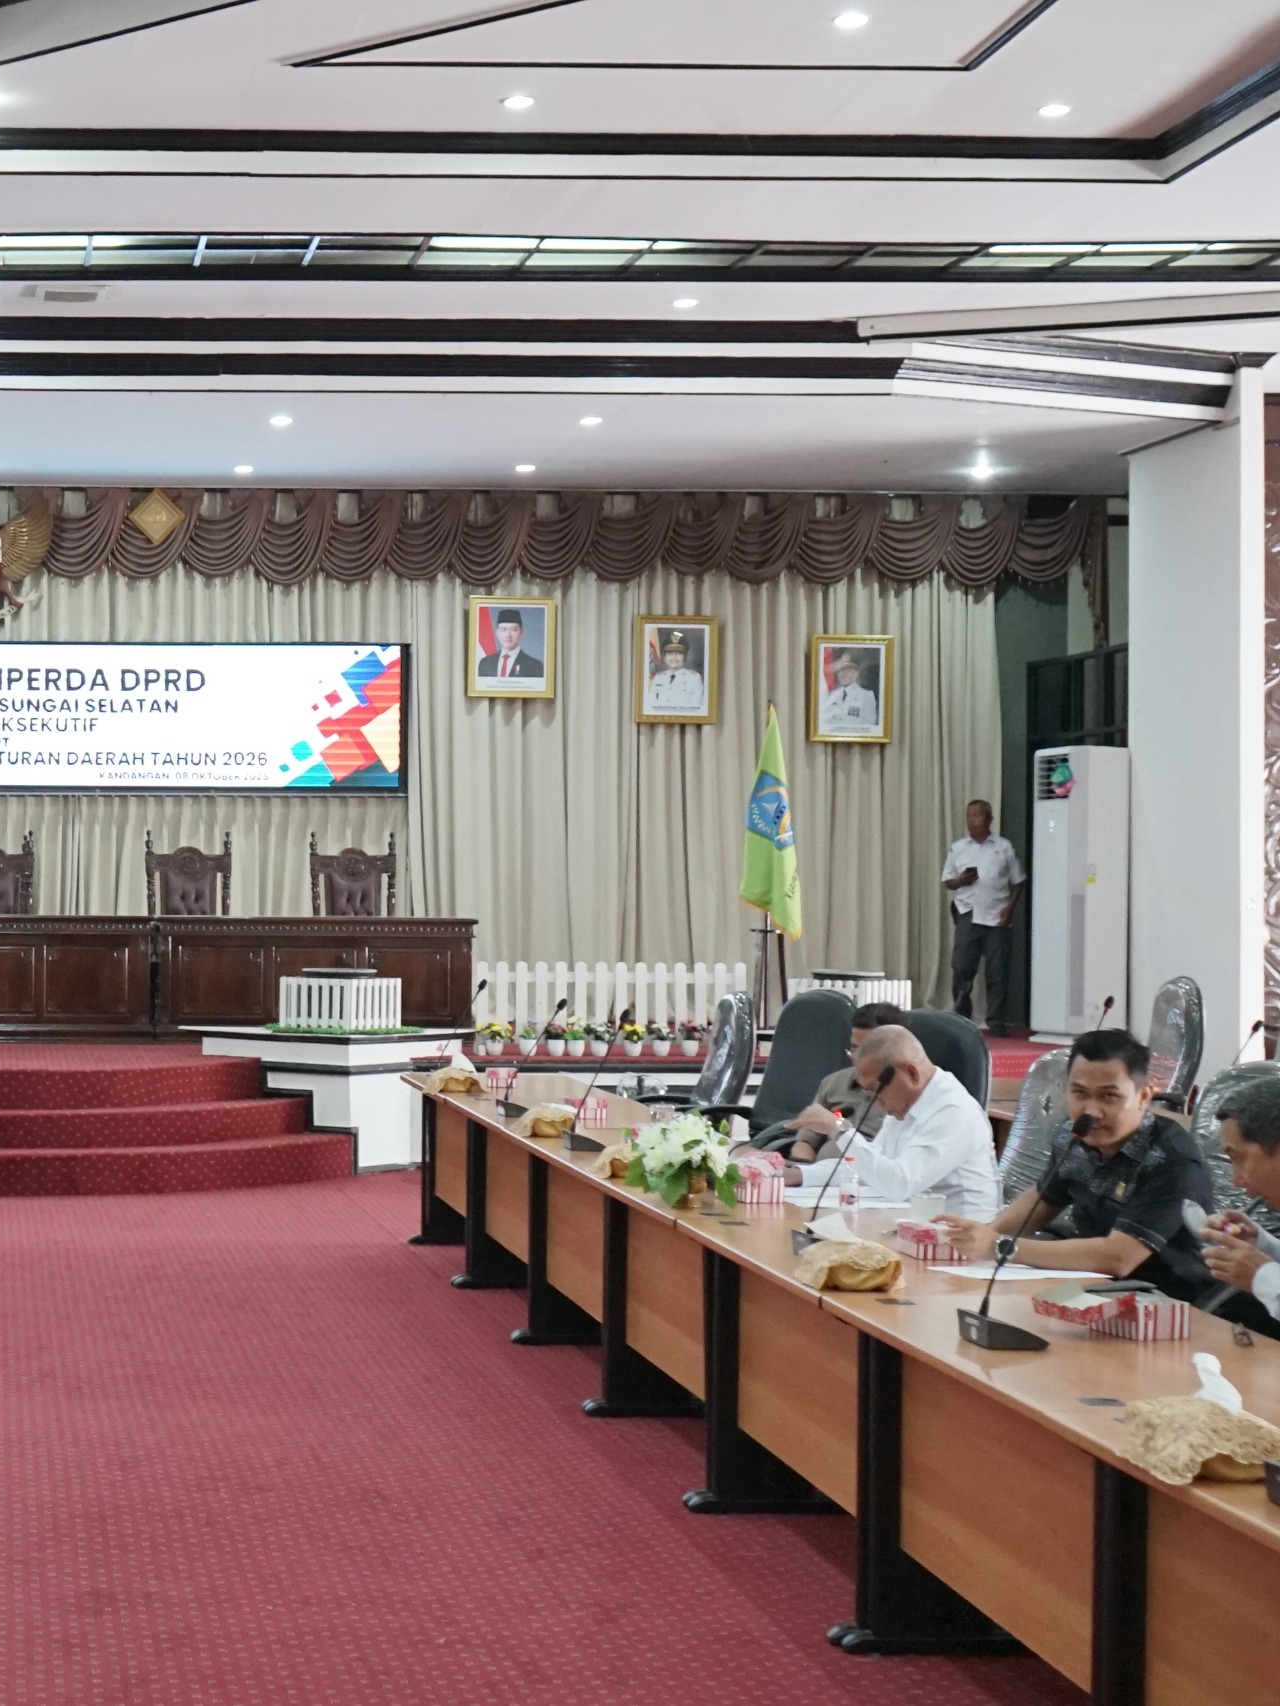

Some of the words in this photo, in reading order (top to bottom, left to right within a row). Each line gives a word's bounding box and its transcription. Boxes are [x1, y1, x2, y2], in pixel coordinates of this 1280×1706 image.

[120, 668, 206, 692] DPRD
[84, 698, 179, 714] SELATAN
[66, 751, 145, 766] DAERAH
[150, 752, 217, 767] TAHUN
[222, 751, 268, 767] 2026
